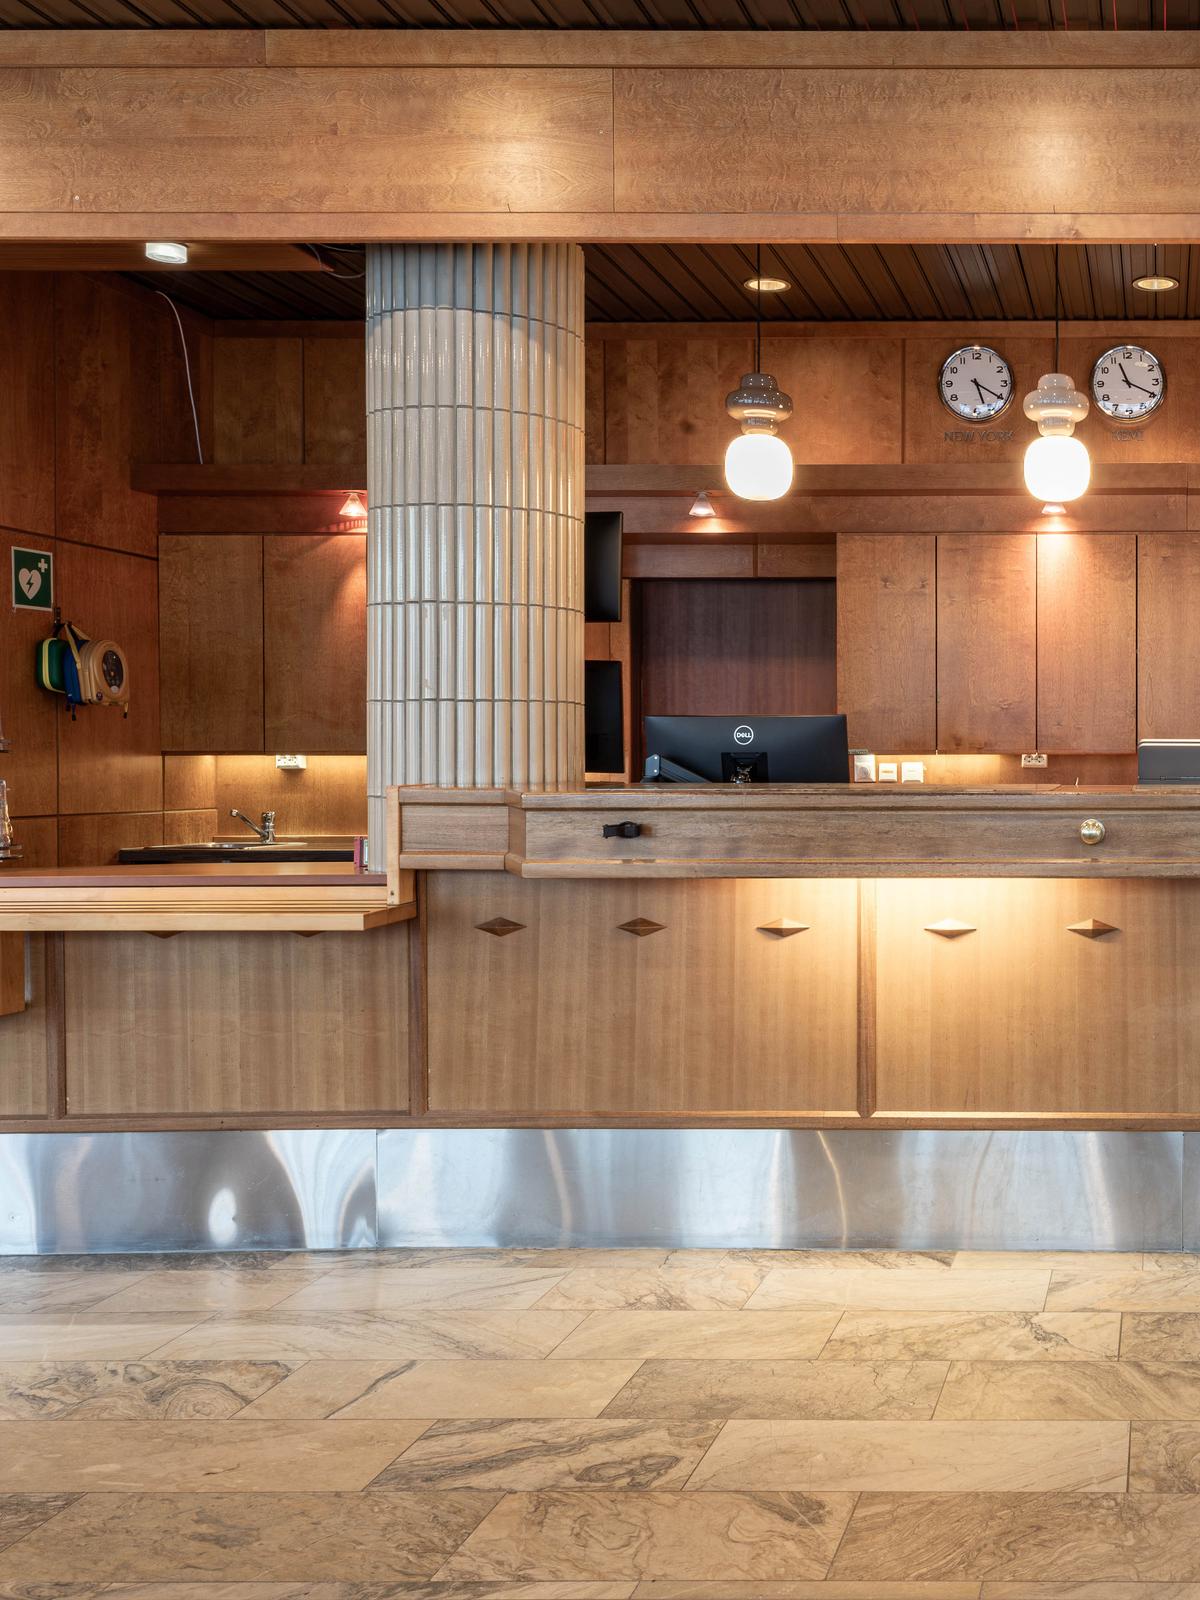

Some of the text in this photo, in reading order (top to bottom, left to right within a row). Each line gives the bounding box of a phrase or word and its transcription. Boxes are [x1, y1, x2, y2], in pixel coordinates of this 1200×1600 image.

[972, 352, 982, 360] 12
[950, 366, 958, 374] 10
[945, 380, 953, 388] 9
[1097, 380, 1104, 388] 9
[1152, 378, 1159, 386] 3
[1112, 403, 1119, 412] 7
[944, 431, 1015, 441] NEW YORK
